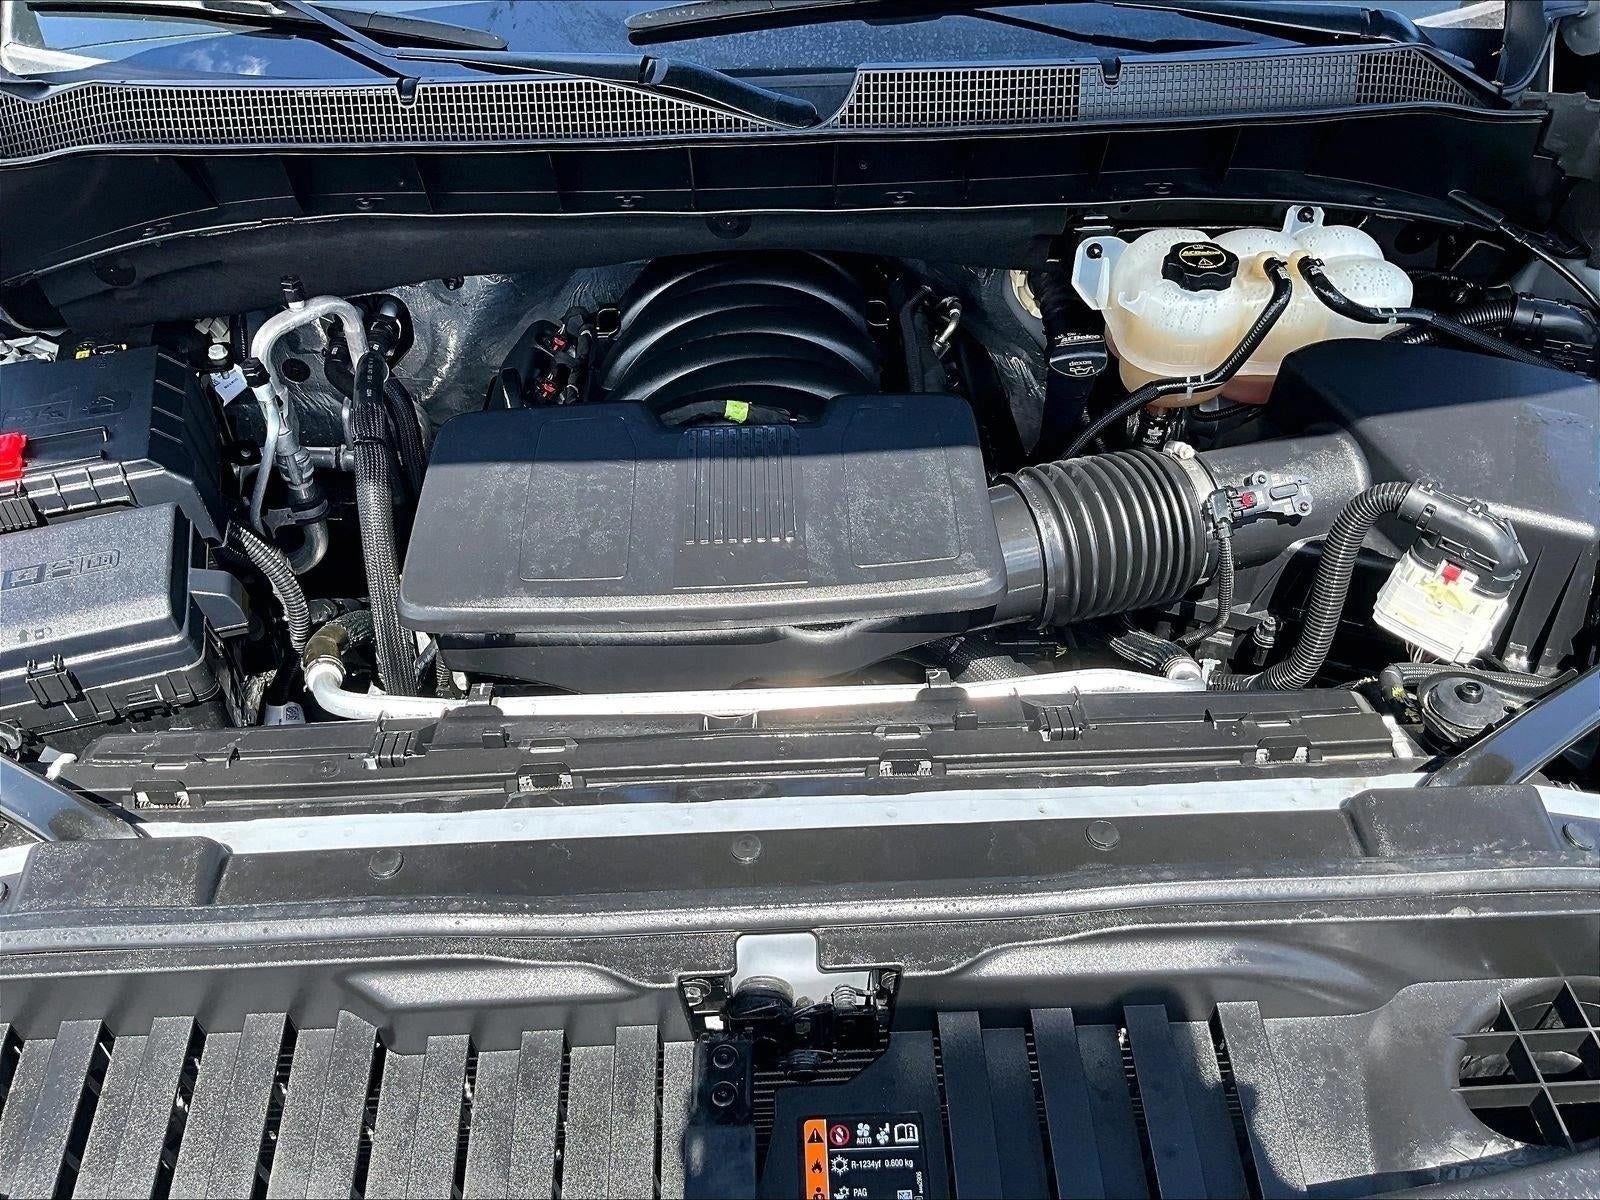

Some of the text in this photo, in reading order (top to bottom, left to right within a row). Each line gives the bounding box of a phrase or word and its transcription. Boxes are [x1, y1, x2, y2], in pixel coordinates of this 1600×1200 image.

[1060, 335, 1100, 344] ACDelco
[856, 1137, 872, 1145] AUTO
[851, 1160, 881, 1169] R-1234yf
[904, 1158, 913, 1167] kg
[853, 1187, 867, 1197] PAG
